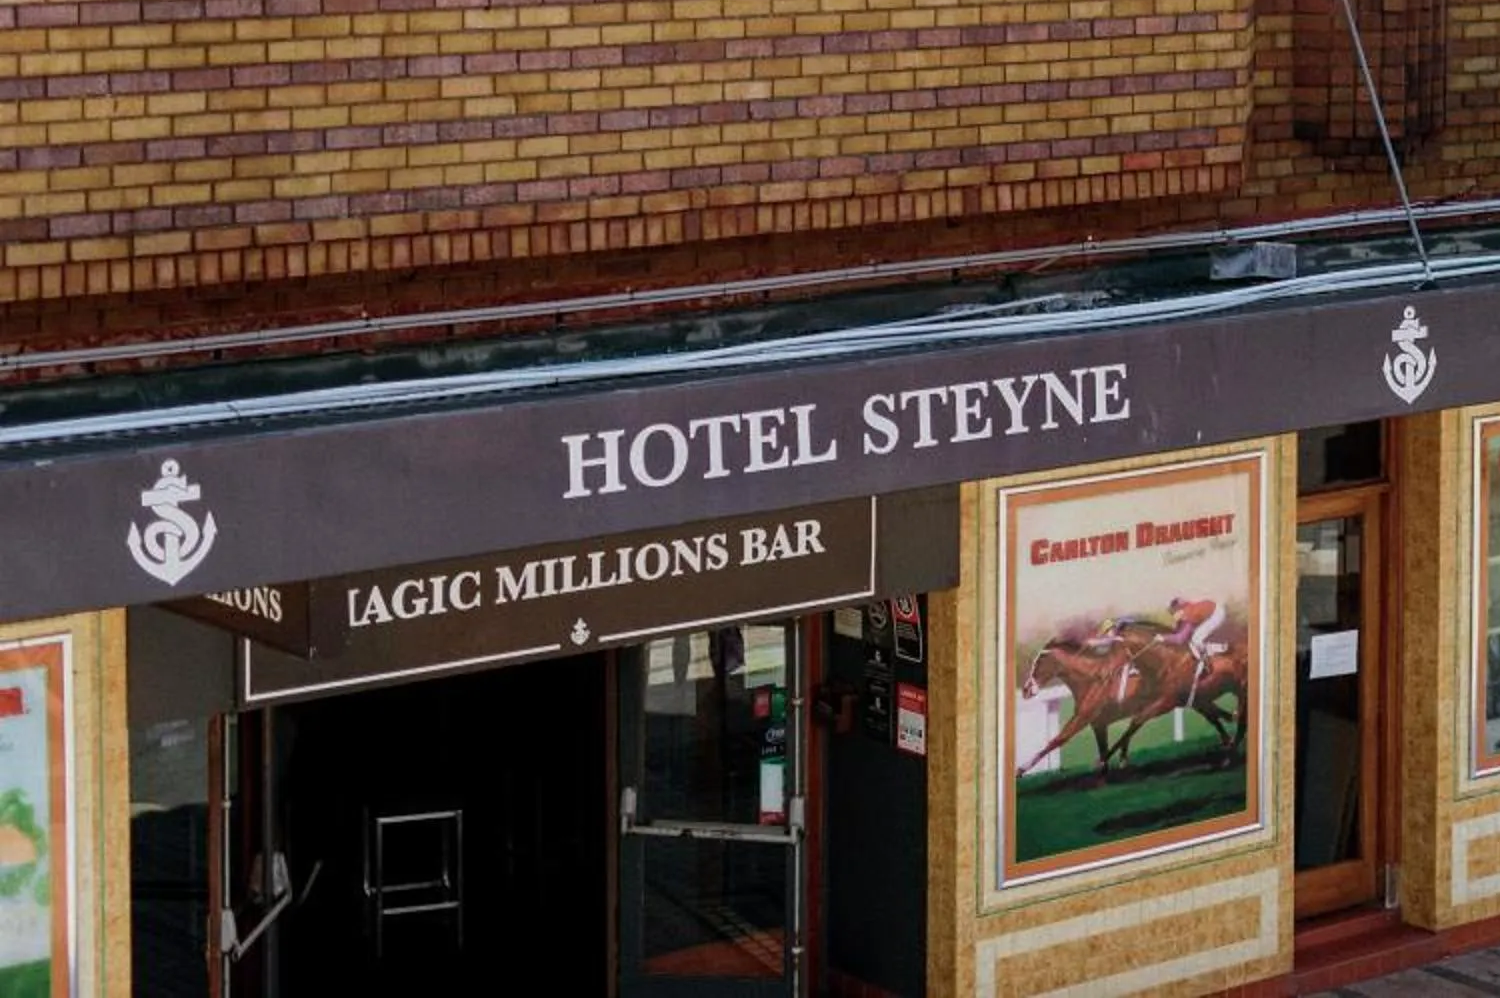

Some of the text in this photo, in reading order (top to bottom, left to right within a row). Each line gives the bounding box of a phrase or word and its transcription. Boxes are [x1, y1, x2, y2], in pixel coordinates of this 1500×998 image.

[561, 363, 1131, 499] HOTEL STEYNE
[495, 533, 730, 605] MILLIONS
[738, 518, 826, 566] BAR
